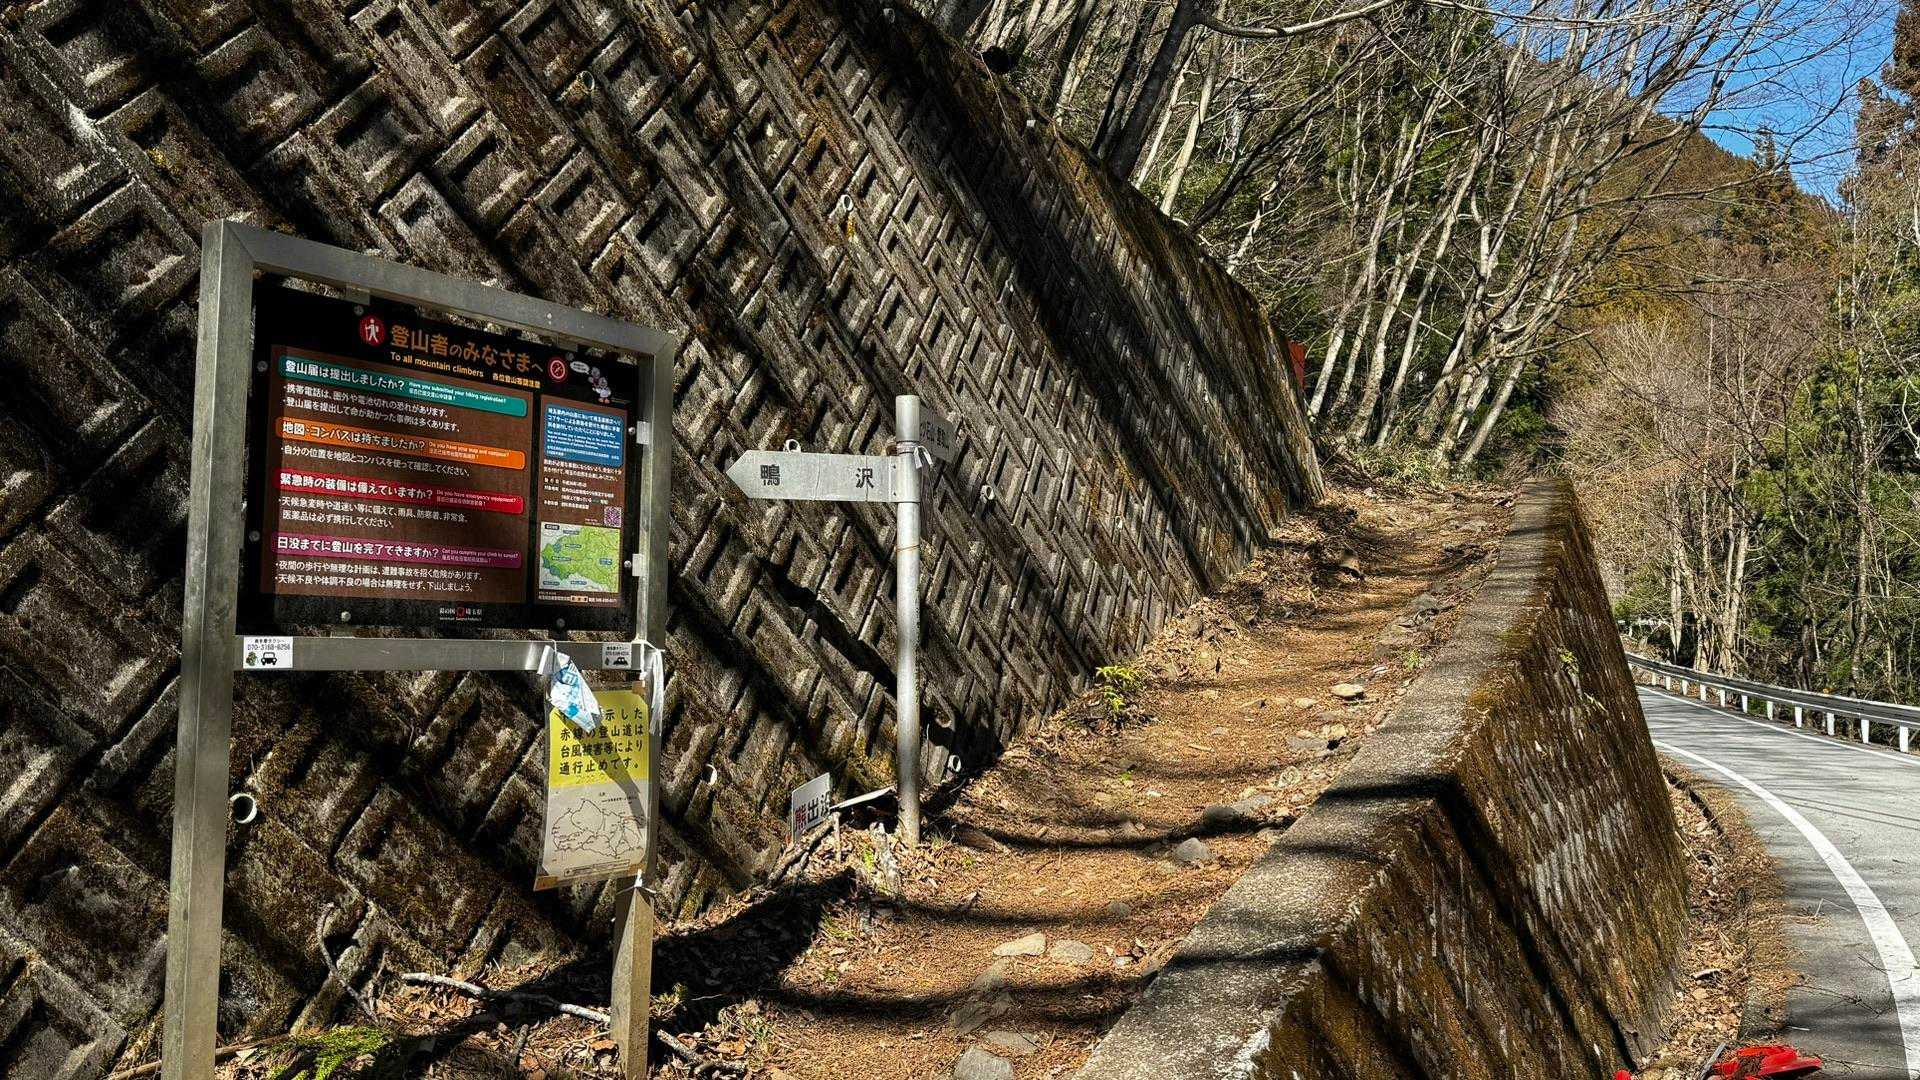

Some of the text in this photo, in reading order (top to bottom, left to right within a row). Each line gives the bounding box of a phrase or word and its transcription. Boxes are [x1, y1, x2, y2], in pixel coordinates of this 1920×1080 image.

[391, 324, 544, 373] 登山者のみなさまへ
[285, 360, 404, 391] 登山届は提出しましたか？
[390, 351, 484, 378] To all mountain climbers
[280, 472, 432, 499] 緊急時の装備は備えていますか？
[277, 537, 439, 558] 日没までに登山を完了できますか？
[559, 758, 639, 776] 通行止めです。
